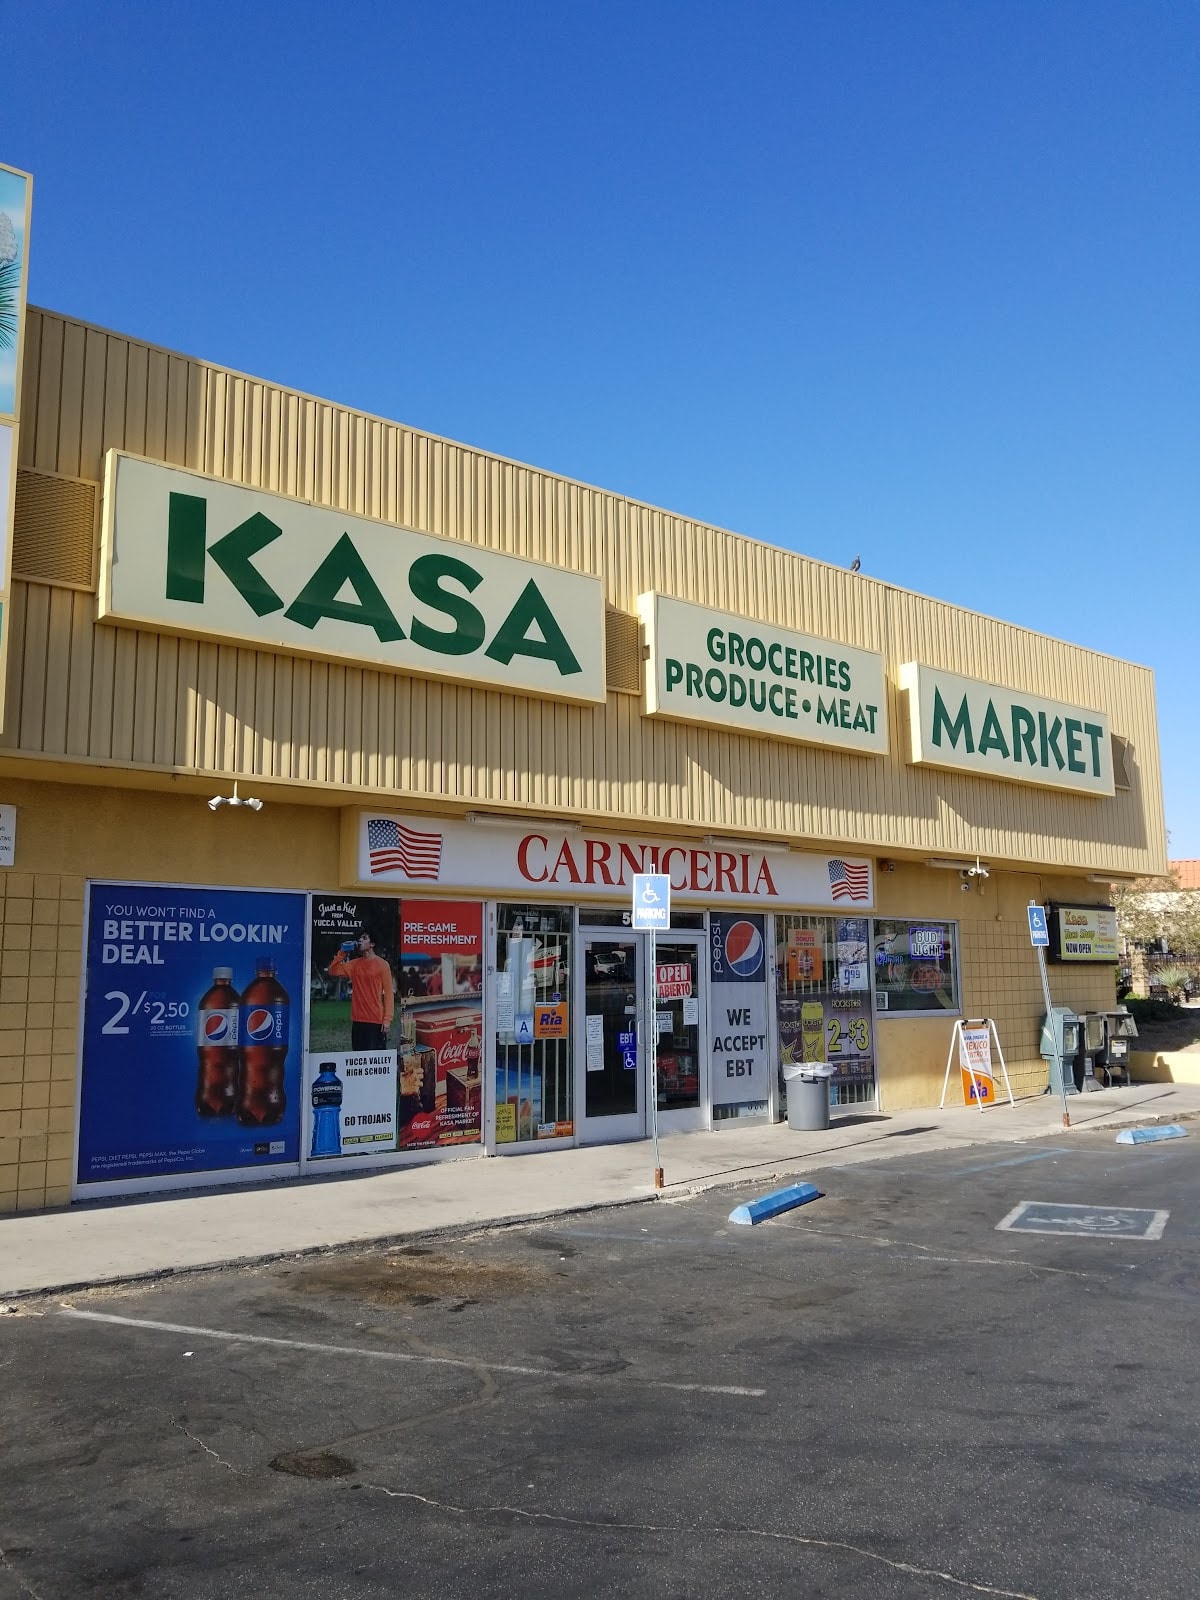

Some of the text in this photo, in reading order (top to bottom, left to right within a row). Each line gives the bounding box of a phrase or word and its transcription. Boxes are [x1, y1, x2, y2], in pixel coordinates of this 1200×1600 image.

[165, 491, 583, 677] KASA
[706, 626, 852, 692] GROCERIES
[665, 658, 878, 734] PRODUCE MEAT
[931, 685, 1103, 777] MARKET
[517, 834, 779, 896] CARNICERIA
[105, 904, 216, 919] YOU WON'T FIND A
[342, 901, 357, 917] Kid
[636, 907, 666, 920] PARKING
[103, 919, 288, 943] BETTER LOOKIN'
[313, 919, 335, 927] YUCCA
[403, 922, 457, 933] PRE-GAME
[403, 934, 478, 945] REFRESHMENT
[915, 930, 938, 944] BUD
[102, 943, 165, 965] DEAL
[711, 922, 723, 973] pepsi
[911, 943, 942, 957] LIGHT
[1065, 943, 1078, 953] NOW
[1078, 944, 1092, 954] OPEN
[659, 965, 688, 982] OPEN
[659, 982, 691, 998] ABIERTO
[275, 1010, 283, 1039] pepsi
[540, 1009, 562, 1026] Ria
[726, 1008, 751, 1026] WE
[520, 1021, 529, 1033] A
[827, 1018, 842, 1052] 2
[619, 1033, 634, 1044] EBT
[712, 1034, 765, 1052] ACCEPT
[345, 1056, 392, 1066] YUCCA VALLEY
[726, 1058, 754, 1077] EBT
[346, 1066, 390, 1077] HIGH SCHOOL
[435, 1112, 471, 1120] REFRESHMENT
[440, 1106, 463, 1114] OFFICIAL
[344, 1113, 392, 1126] GO TROJANS
